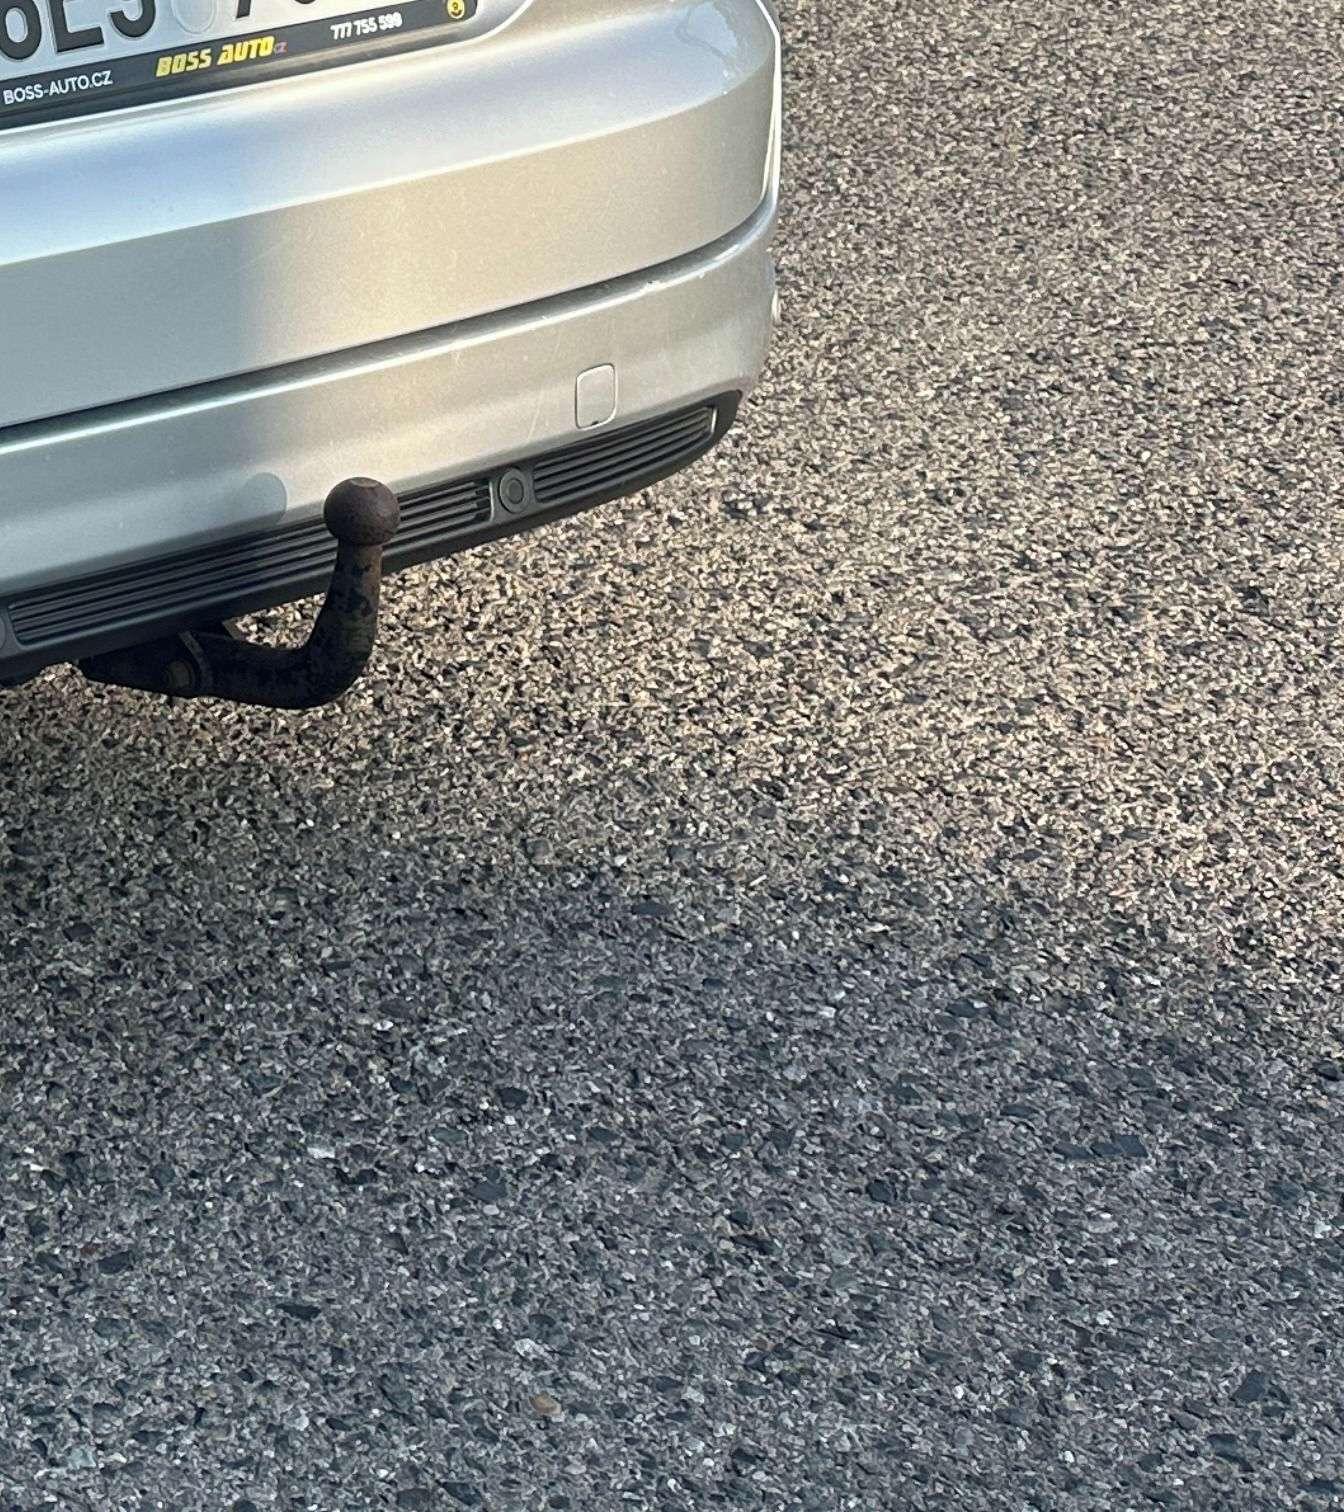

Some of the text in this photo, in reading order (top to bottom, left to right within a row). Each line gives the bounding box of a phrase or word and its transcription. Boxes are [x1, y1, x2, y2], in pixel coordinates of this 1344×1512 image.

[155, 48, 212, 78] BOSS
[216, 35, 275, 66] AUTO
[2, 69, 114, 105] BOSS-AUTO.CZ
